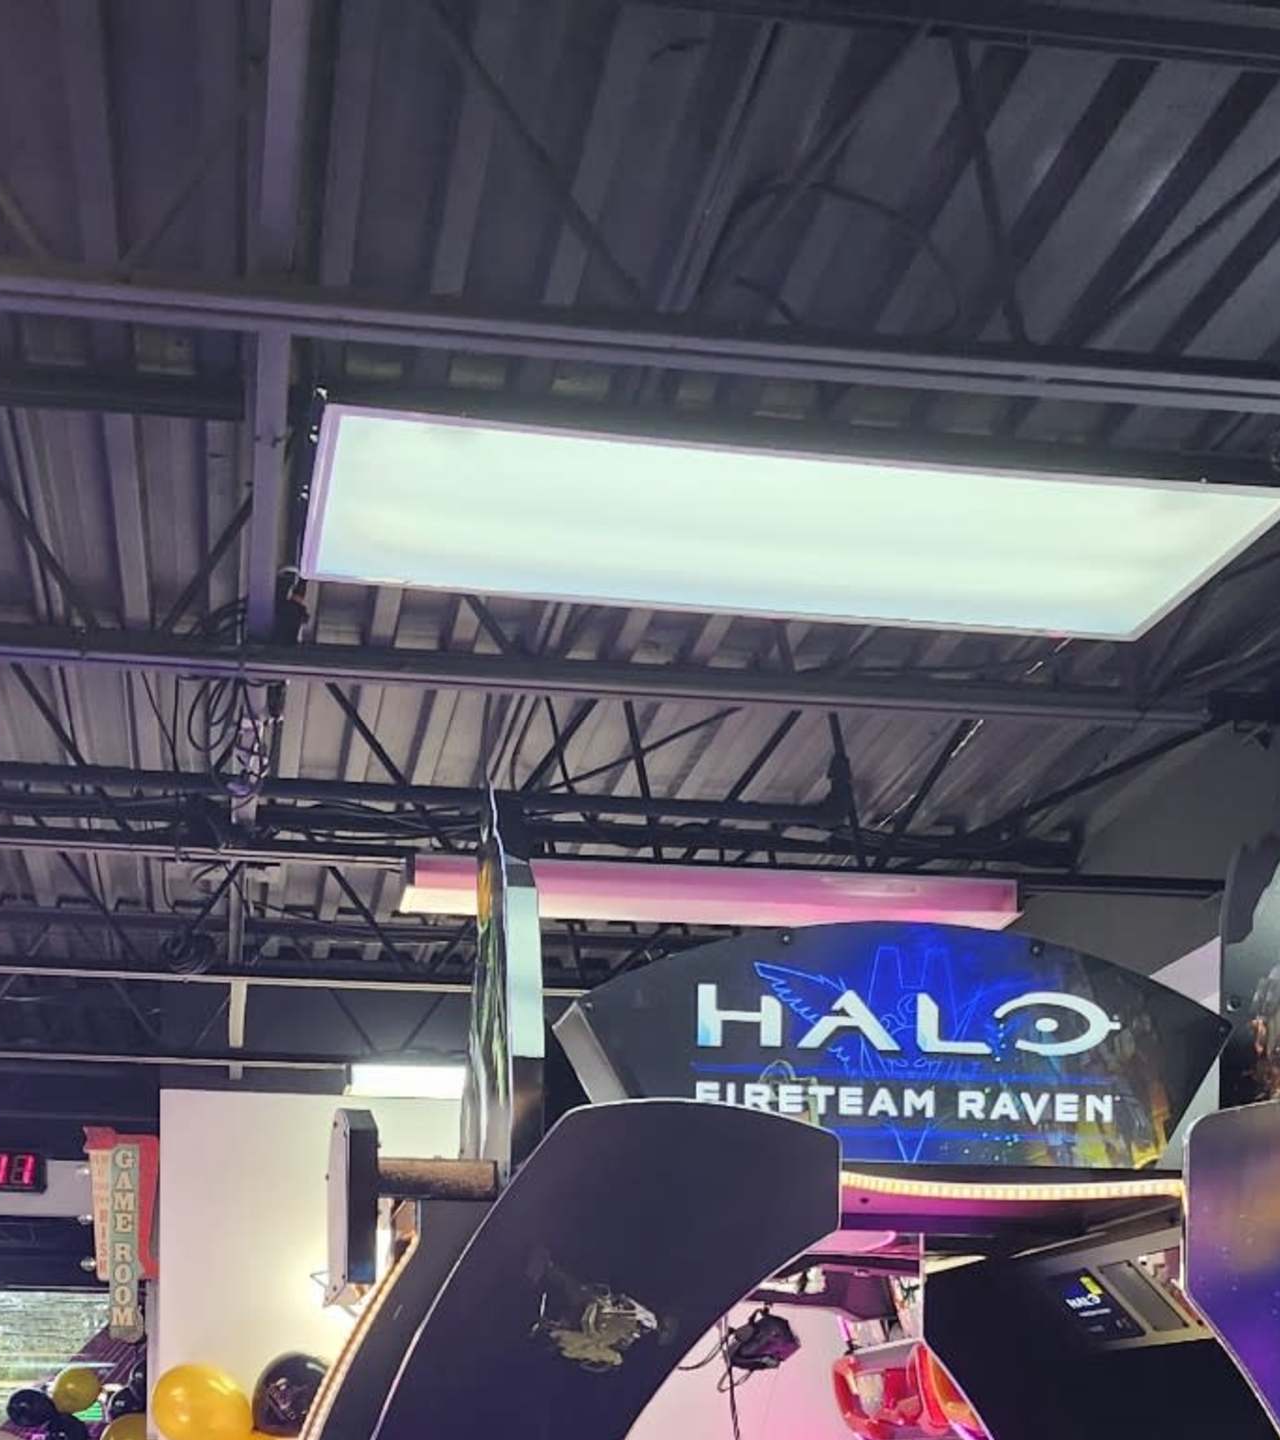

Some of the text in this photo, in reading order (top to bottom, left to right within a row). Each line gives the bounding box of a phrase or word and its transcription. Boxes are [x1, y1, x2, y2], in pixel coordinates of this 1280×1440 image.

[696, 983, 1121, 1056] HALO
[694, 1081, 1113, 1126] FIRETEAM RAVEN
[111, 1150, 135, 1326] GAME ROOM
